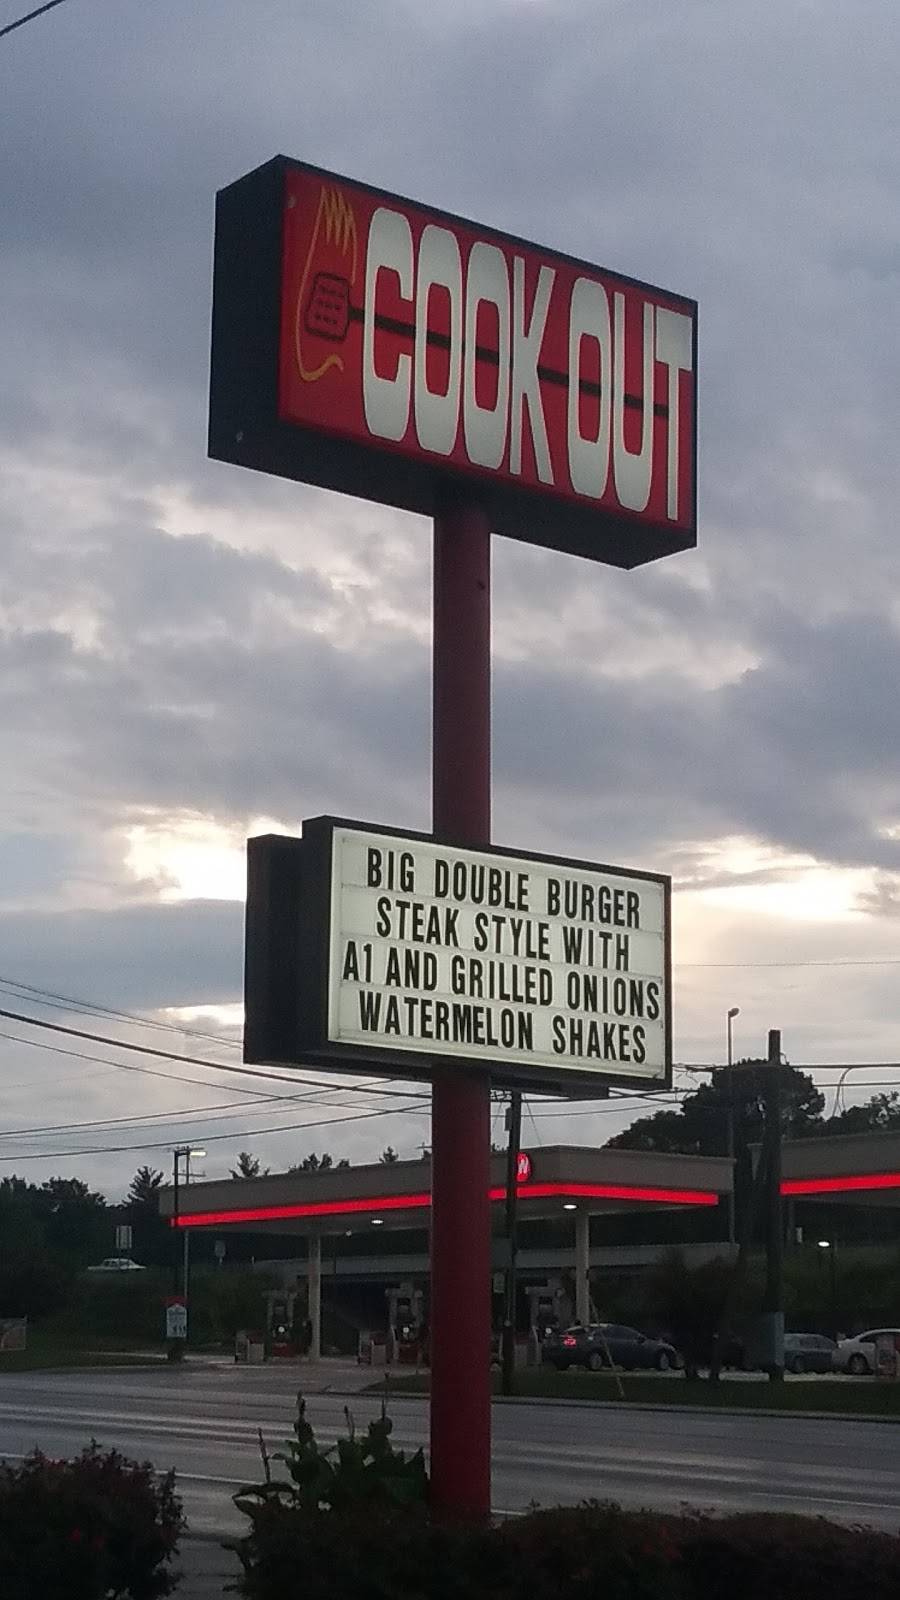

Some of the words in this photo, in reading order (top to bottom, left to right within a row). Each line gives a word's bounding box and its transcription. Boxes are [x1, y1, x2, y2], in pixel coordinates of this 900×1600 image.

[363, 207, 555, 485] COOK
[568, 277, 693, 521] OUT
[367, 847, 415, 893] BIG
[435, 859, 529, 912] DOUBLE
[547, 878, 640, 929] BURGER
[376, 897, 459, 947] STEAK
[474, 912, 550, 960] STYLE
[563, 926, 629, 972] WITH
[343, 940, 372, 983] A1
[386, 947, 437, 991] AND
[452, 955, 553, 1006] GRILLED
[567, 971, 659, 1020] ONIONS
[359, 990, 533, 1050] WATERMELON
[552, 1014, 646, 1064] SHAKES
